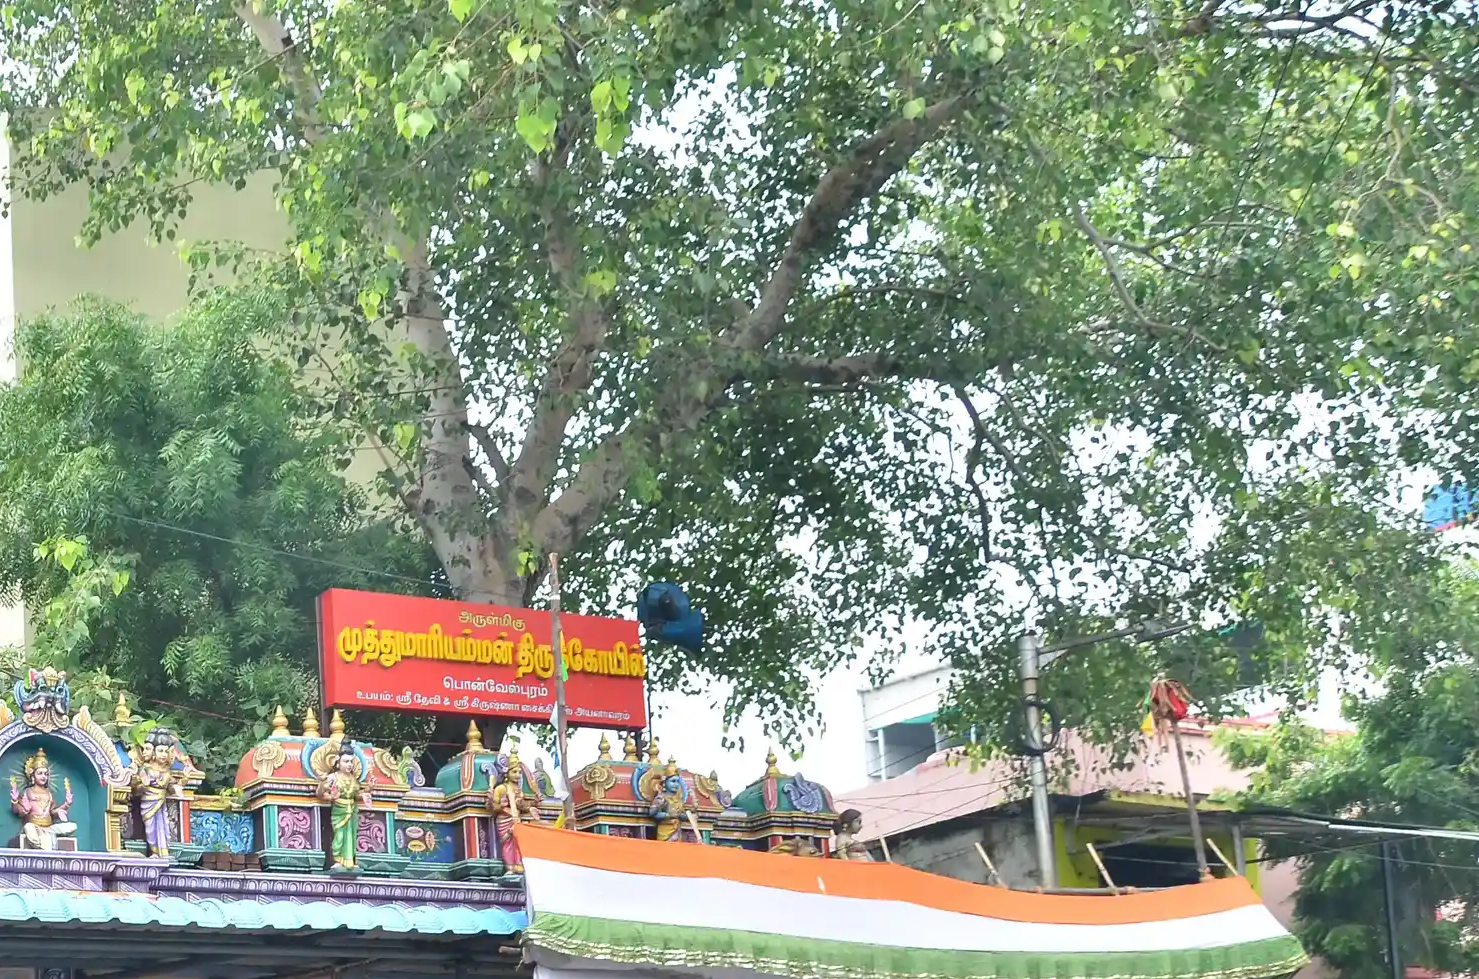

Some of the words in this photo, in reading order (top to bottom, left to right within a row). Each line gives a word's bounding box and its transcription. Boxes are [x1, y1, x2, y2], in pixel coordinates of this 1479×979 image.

[458, 609, 526, 631] அருள்மிகு
[337, 620, 513, 668] முத்துமாரியம்மன்
[443, 697, 450, 706] &
